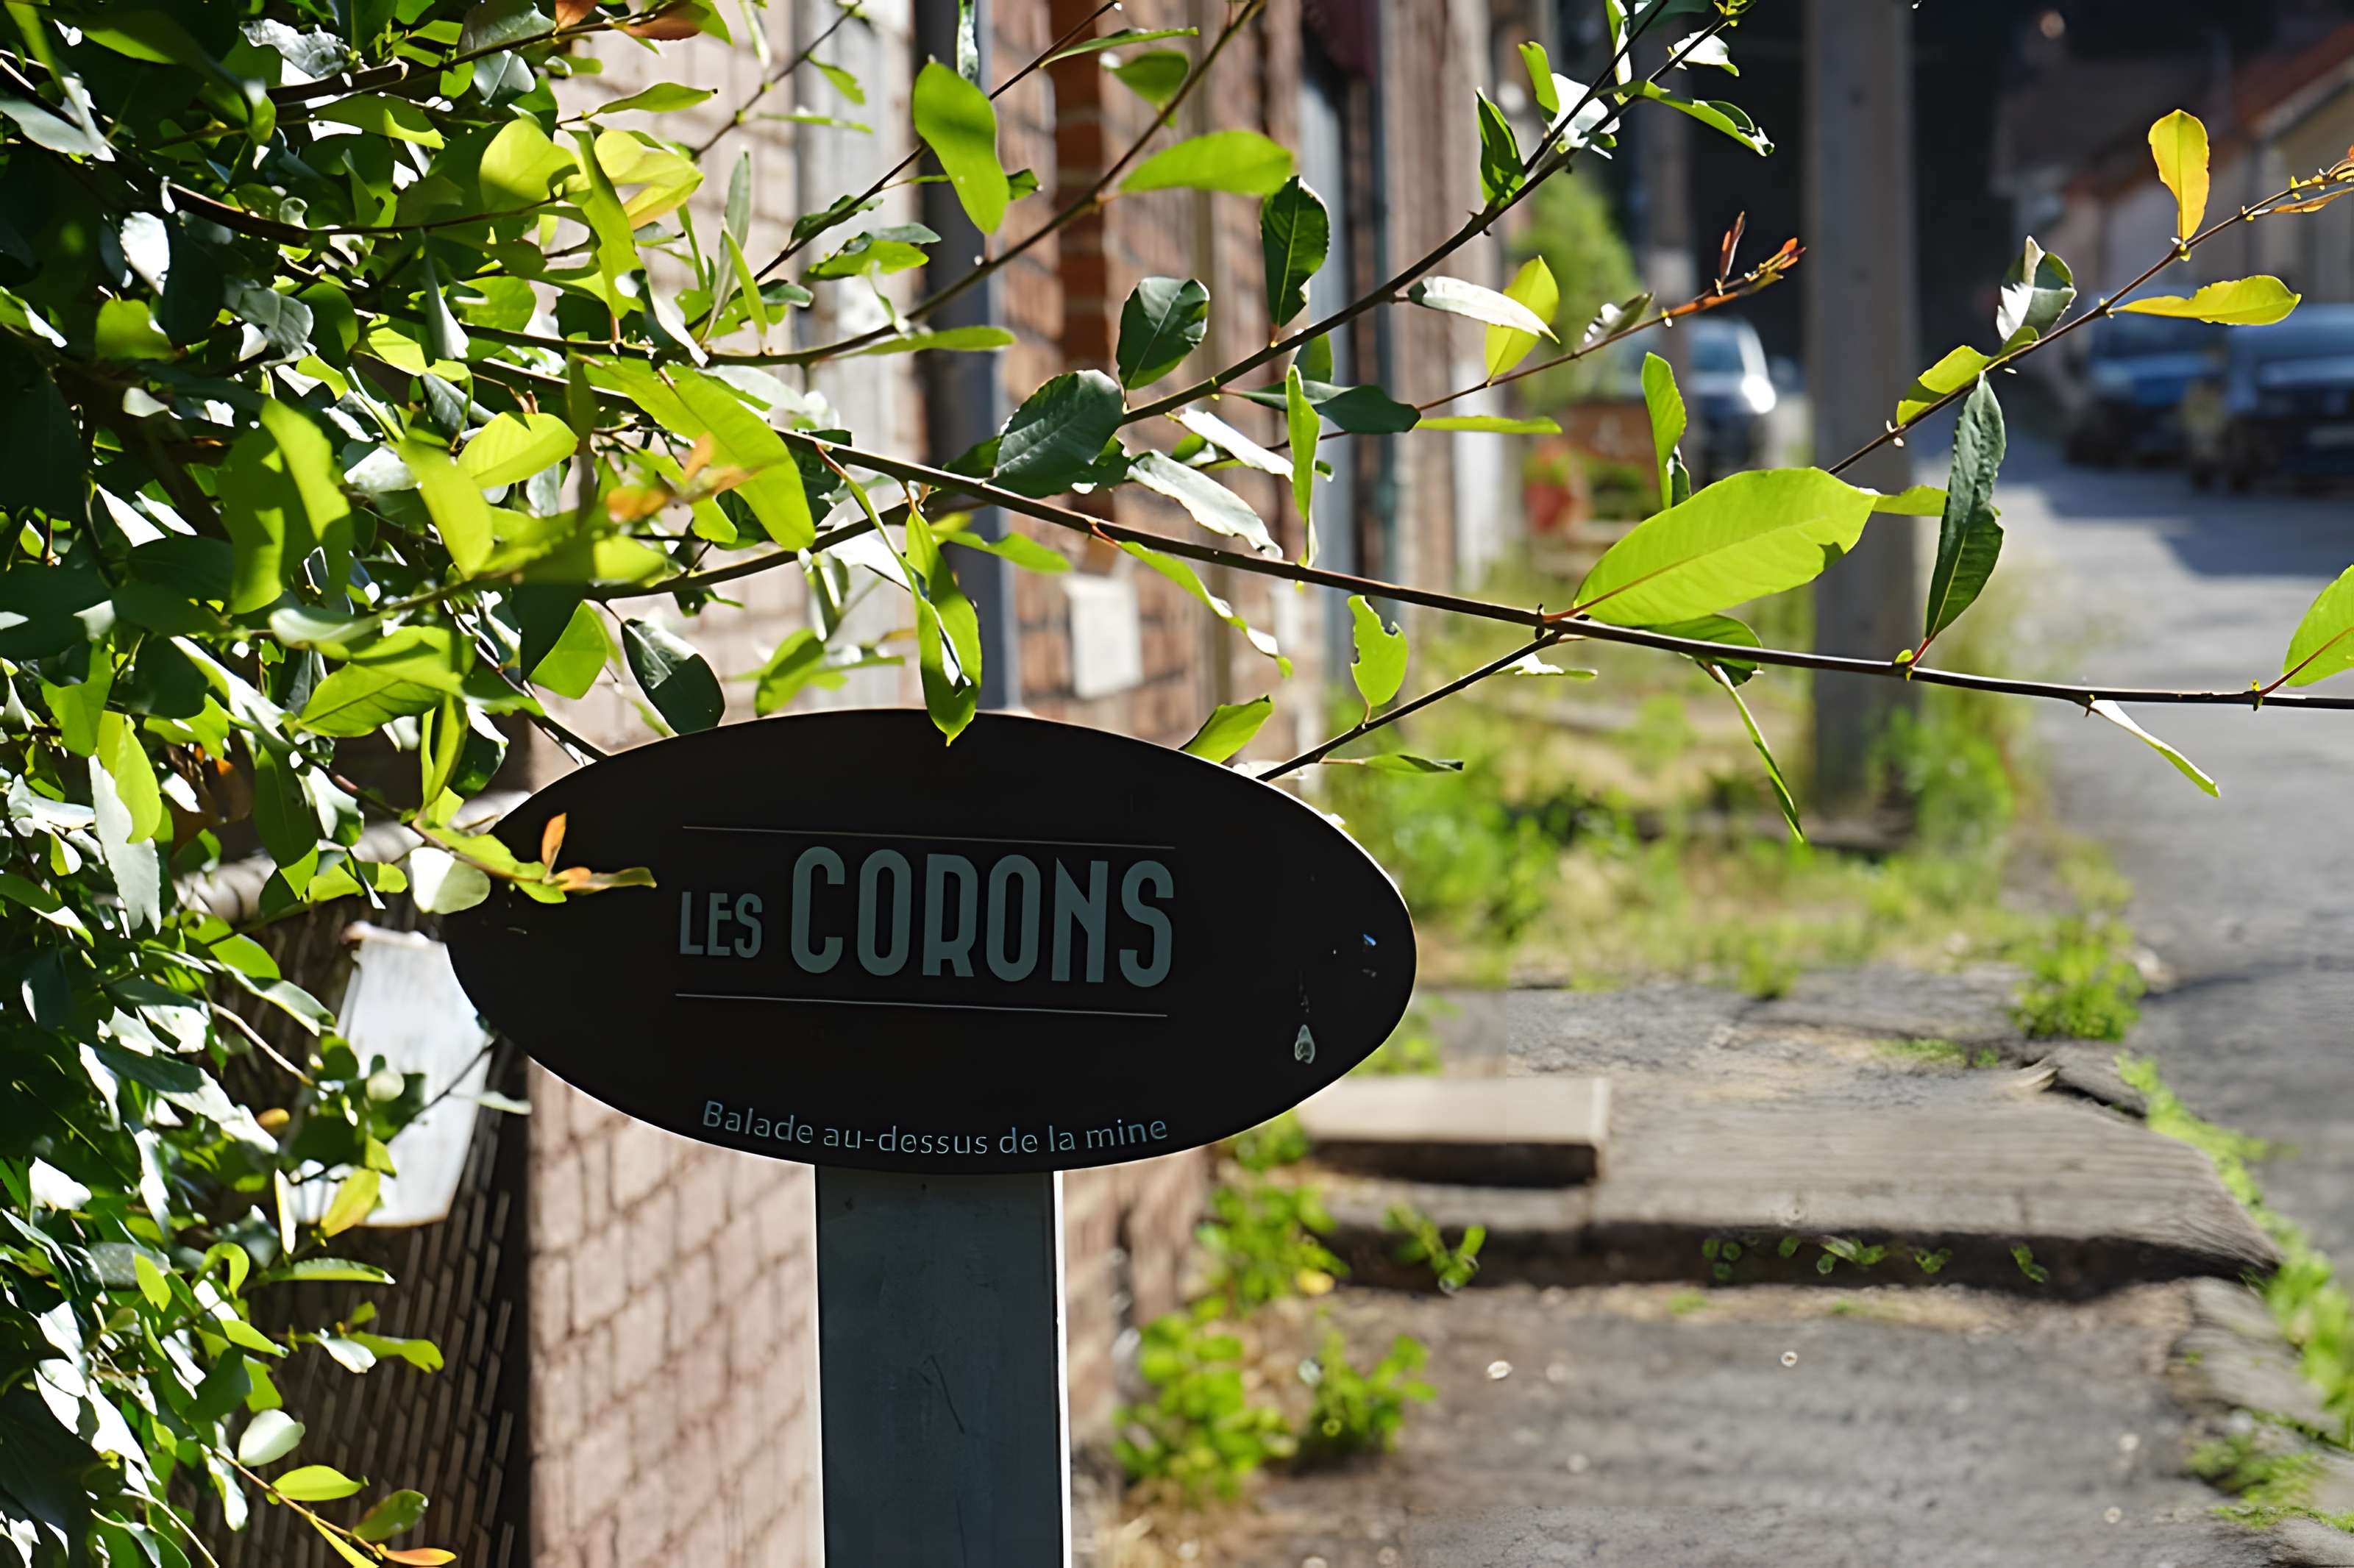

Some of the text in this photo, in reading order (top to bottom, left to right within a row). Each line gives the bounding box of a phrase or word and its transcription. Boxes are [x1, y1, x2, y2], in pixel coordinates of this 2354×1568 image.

[678, 846, 1175, 988] LES CORONS
[703, 1100, 1168, 1155] Balade au-dessus de la mine
